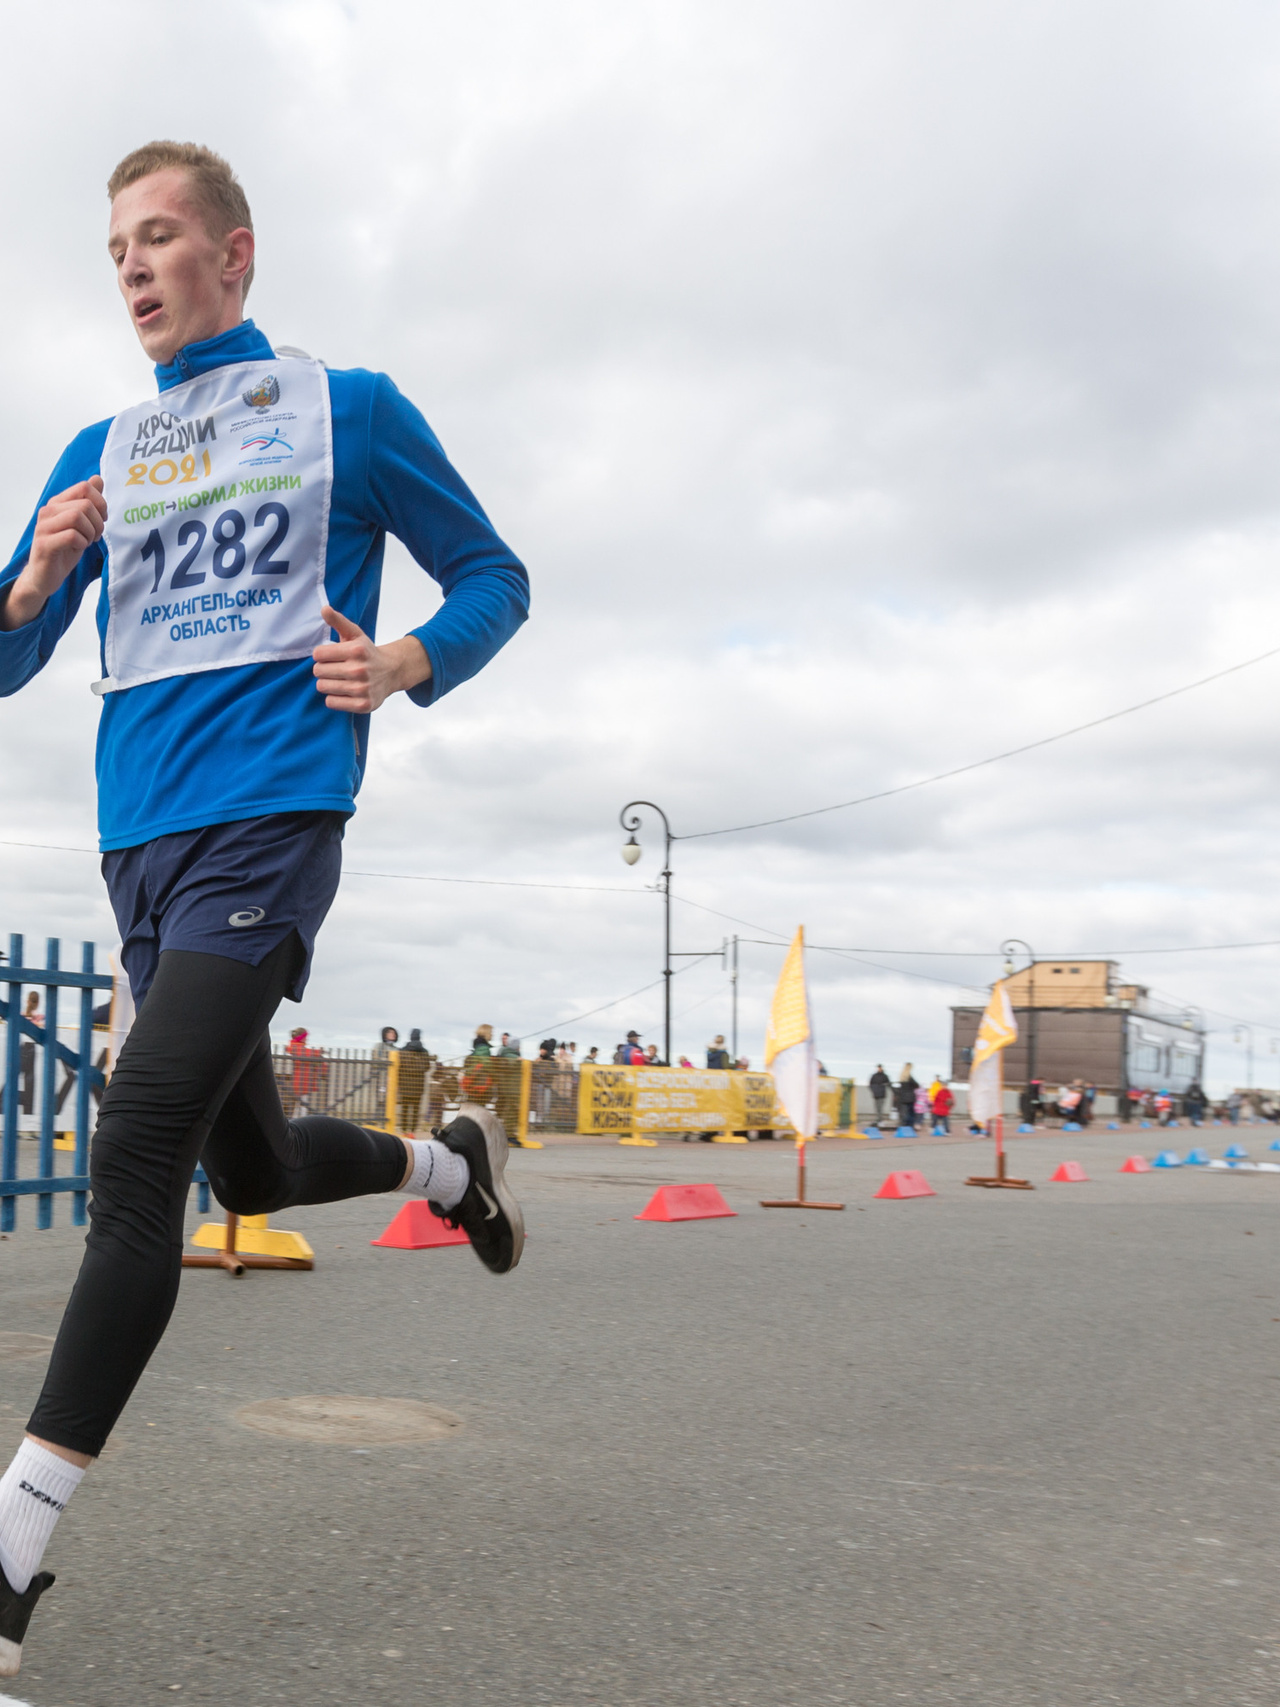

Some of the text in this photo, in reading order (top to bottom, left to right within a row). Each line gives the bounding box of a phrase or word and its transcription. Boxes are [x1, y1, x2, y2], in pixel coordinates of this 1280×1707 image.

[130, 416, 217, 459] НАЦИИ
[136, 411, 182, 440] КРО
[124, 448, 211, 487] 2021
[123, 475, 302, 525] СПОРТ НОРМА ЖИЗНИ
[140, 501, 290, 594] 1282
[140, 588, 282, 625] АРХАНГЕЛЬСКАЯ
[170, 614, 251, 642] ОБЛАСТЬ
